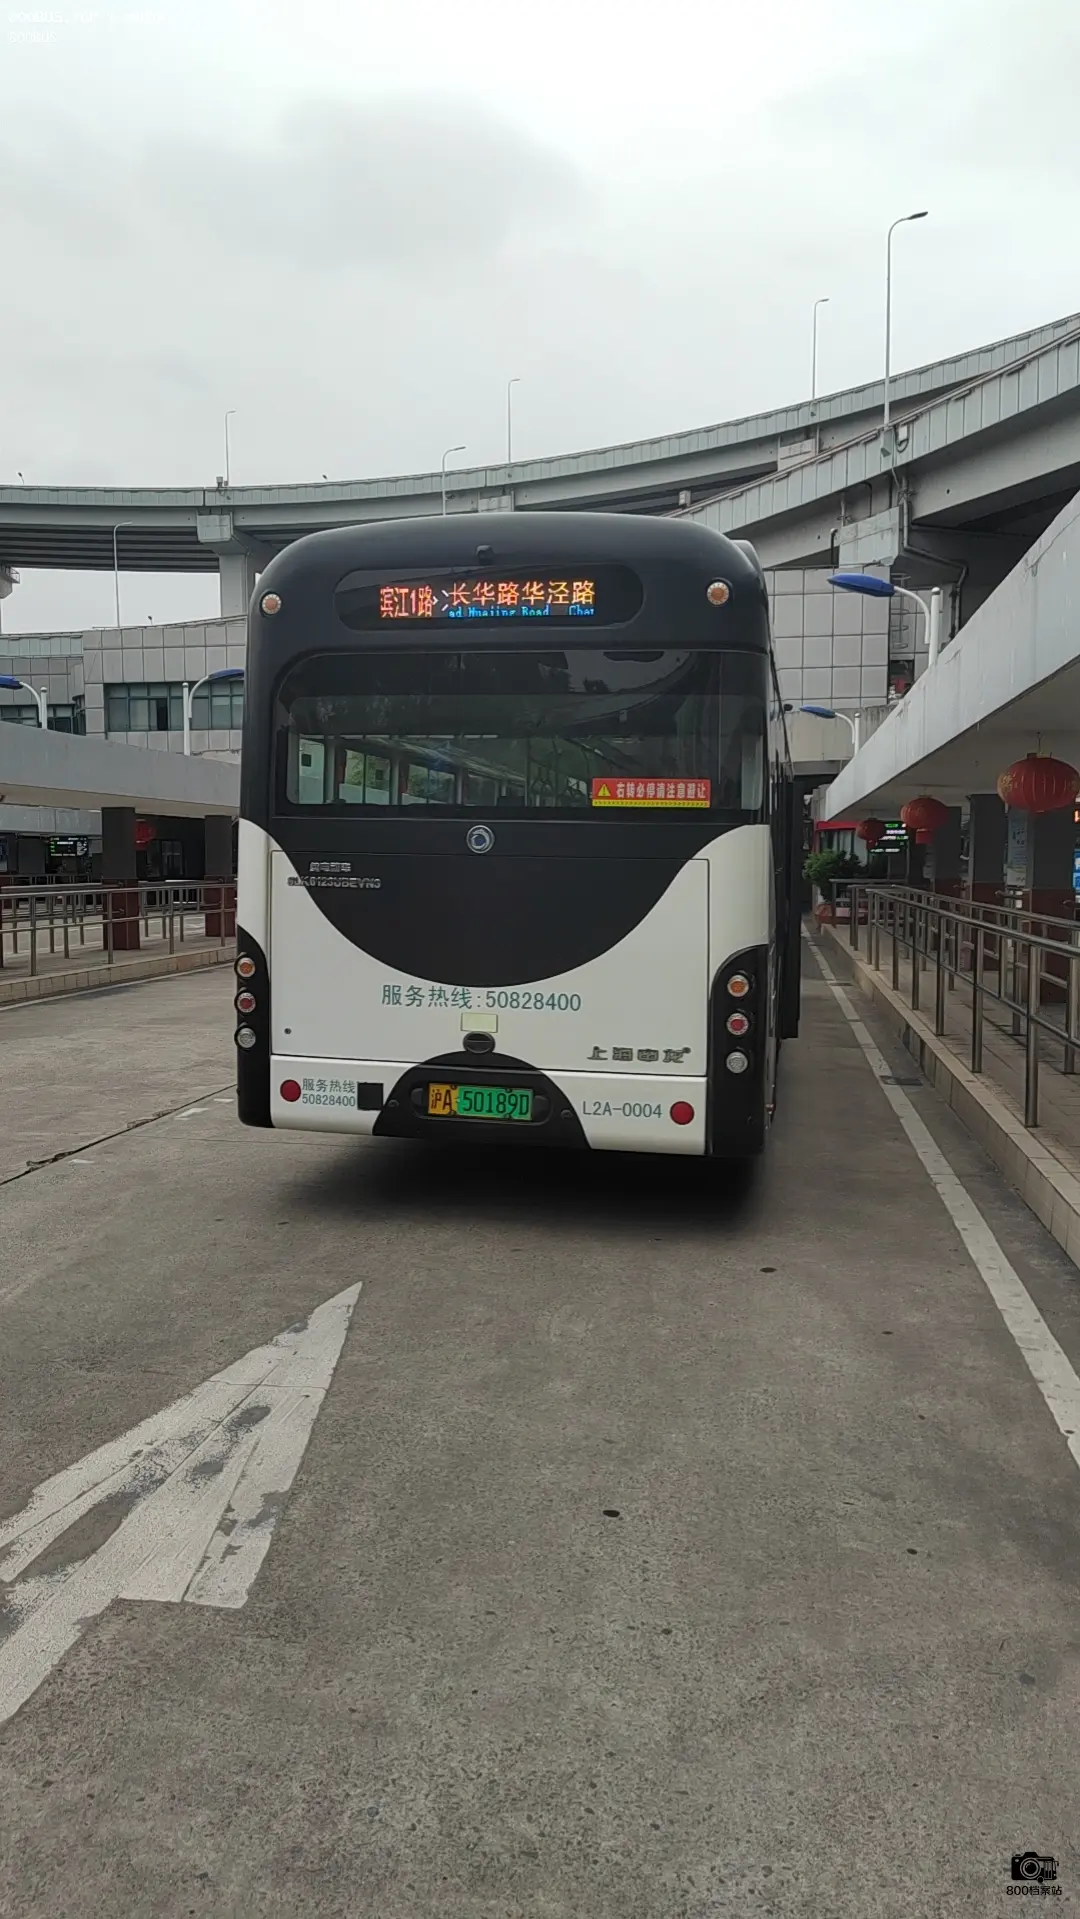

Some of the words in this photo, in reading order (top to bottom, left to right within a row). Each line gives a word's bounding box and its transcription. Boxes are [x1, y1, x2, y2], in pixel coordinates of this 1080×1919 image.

[380, 585, 433, 618] 滨江1路
[449, 580, 595, 606] 长华路华泾路
[521, 603, 550, 617] Road
[616, 782, 706, 799] 右转必停请注意避让
[302, 1078, 356, 1093] 服务热线
[302, 1093, 356, 1107] 50828400
[583, 1101, 663, 1118] L2A-0004
